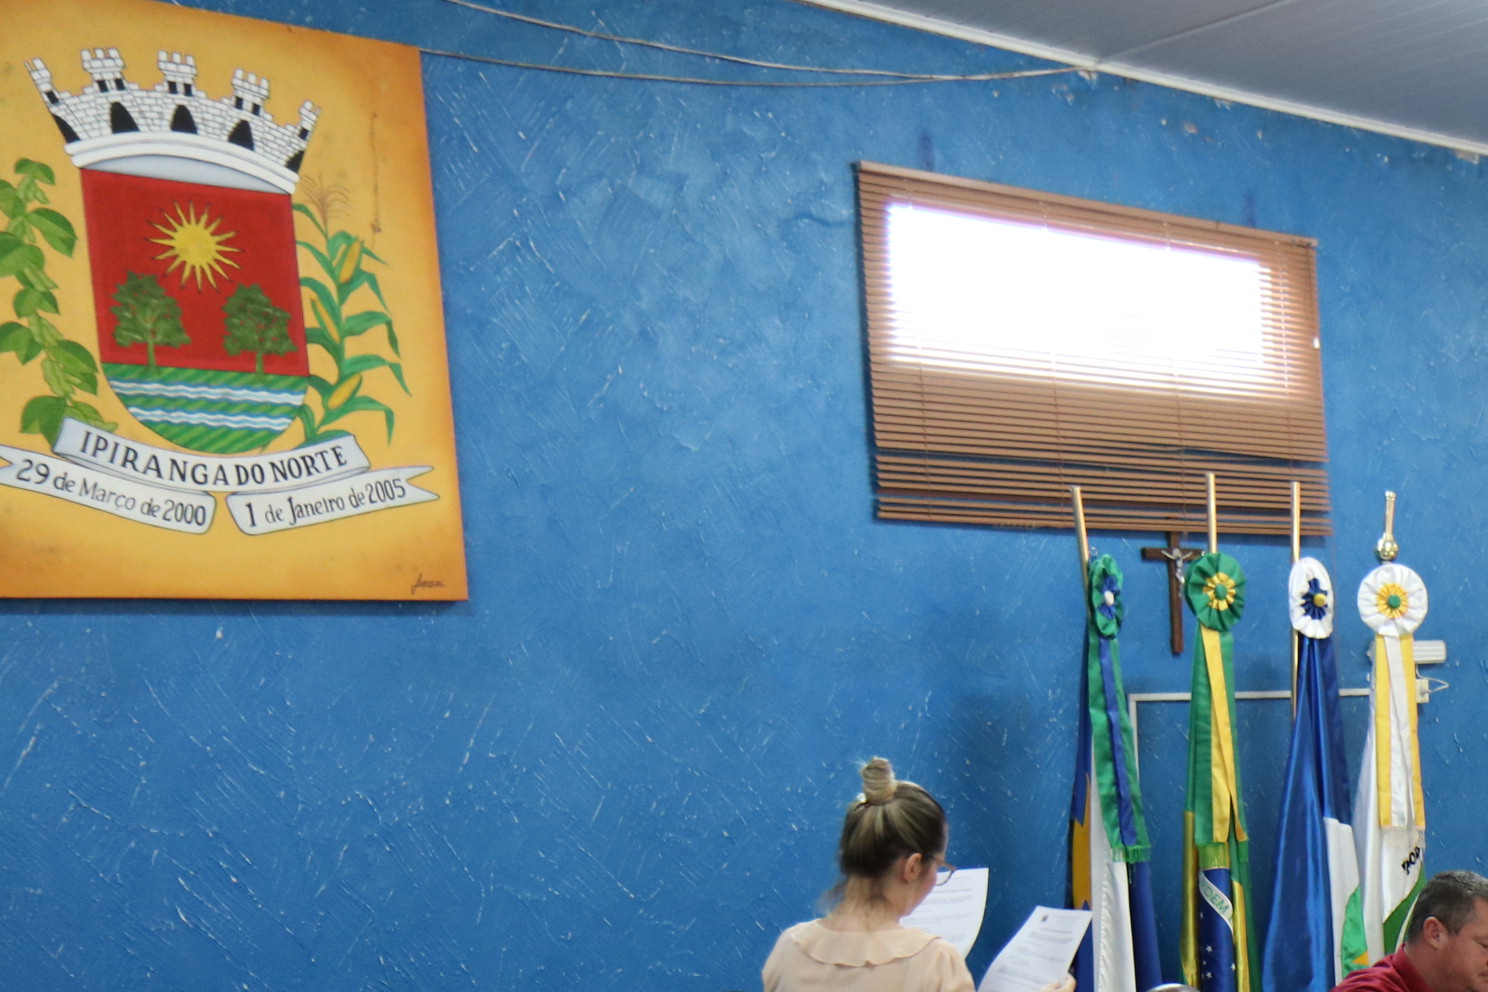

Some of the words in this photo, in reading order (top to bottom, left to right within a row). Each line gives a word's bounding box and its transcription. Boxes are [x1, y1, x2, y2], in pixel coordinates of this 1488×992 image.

[80, 430, 229, 487] IPIRANGA
[236, 464, 266, 487] DO
[272, 445, 348, 483] NORTE
[15, 459, 51, 484] 29
[53, 470, 76, 493] de
[78, 475, 136, 513] Março
[139, 497, 161, 519] de
[162, 499, 206, 527] 2000
[246, 503, 257, 528] 1
[264, 502, 284, 523] de
[288, 490, 346, 526] Janeiro
[348, 487, 367, 508] de
[365, 477, 407, 502] 2005
